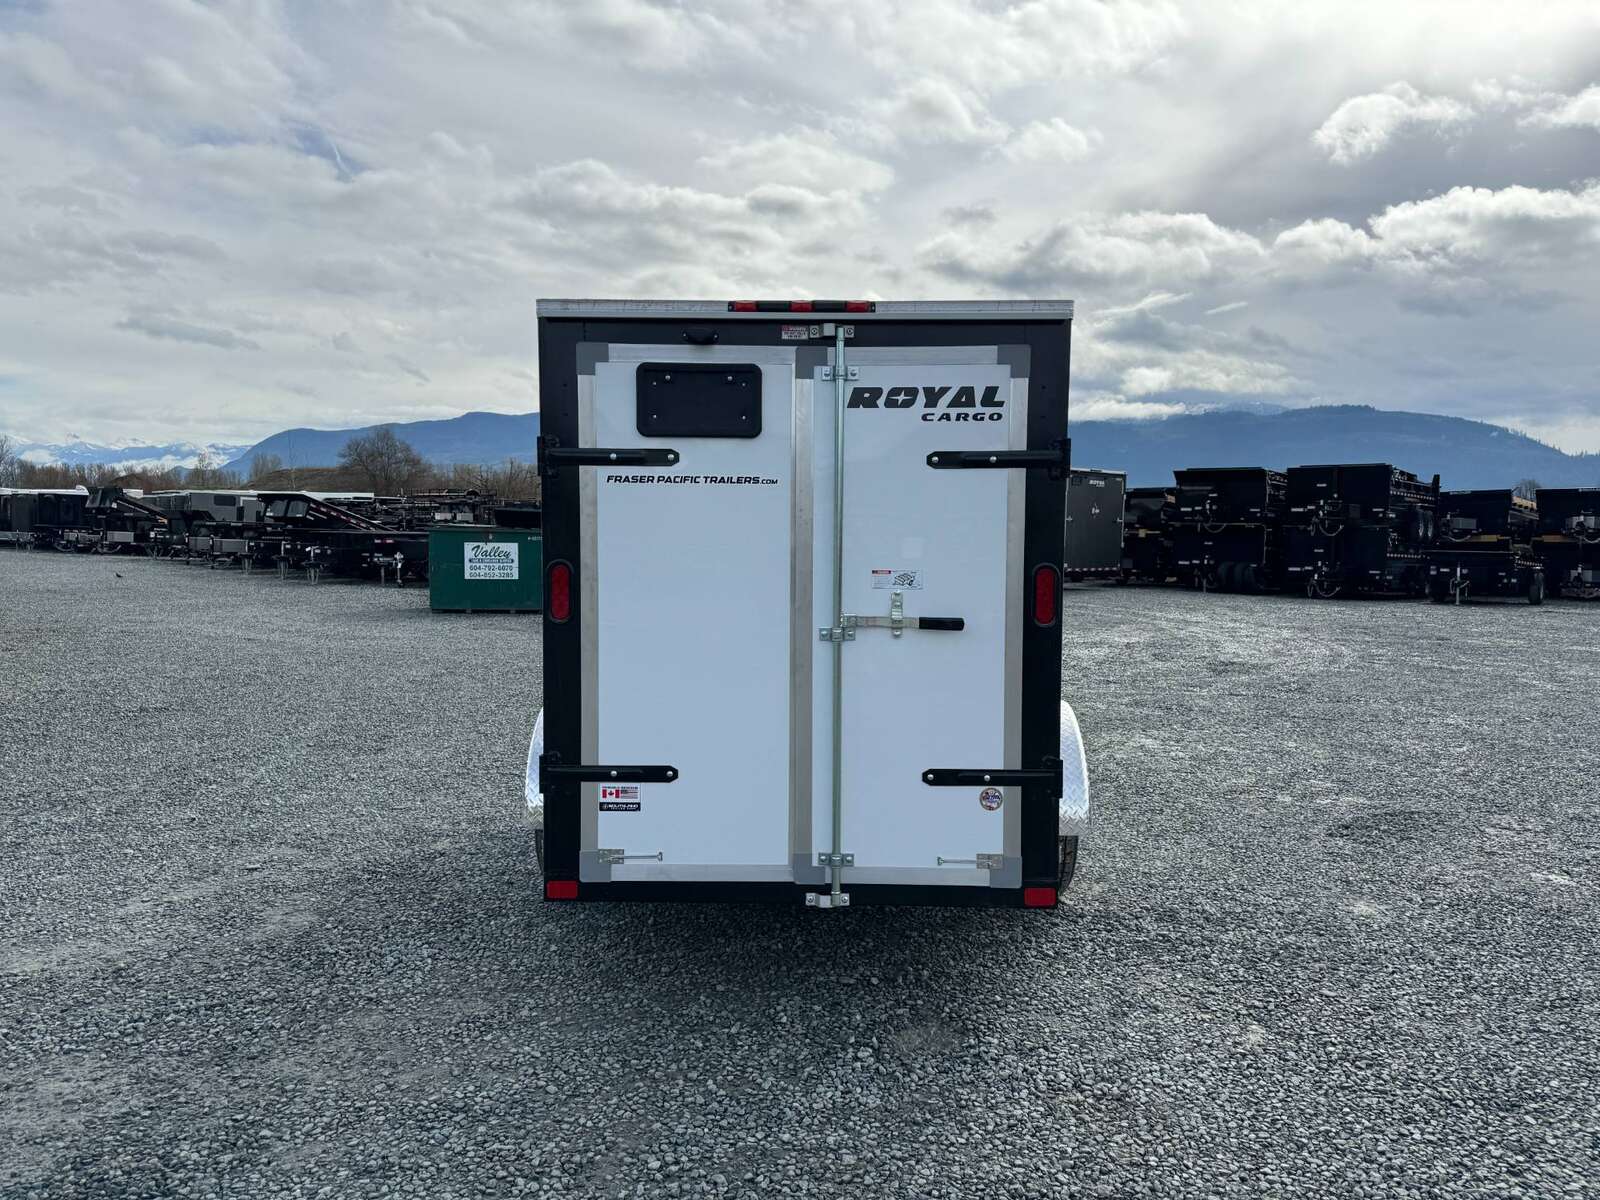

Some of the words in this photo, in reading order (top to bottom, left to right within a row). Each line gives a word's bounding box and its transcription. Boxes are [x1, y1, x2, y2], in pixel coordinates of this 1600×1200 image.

[846, 385, 1006, 409] ROYAL
[921, 412, 1003, 422] CARGO
[606, 475, 655, 484] FRASER
[656, 475, 701, 484] PACIFIC
[471, 544, 511, 558] Valley
